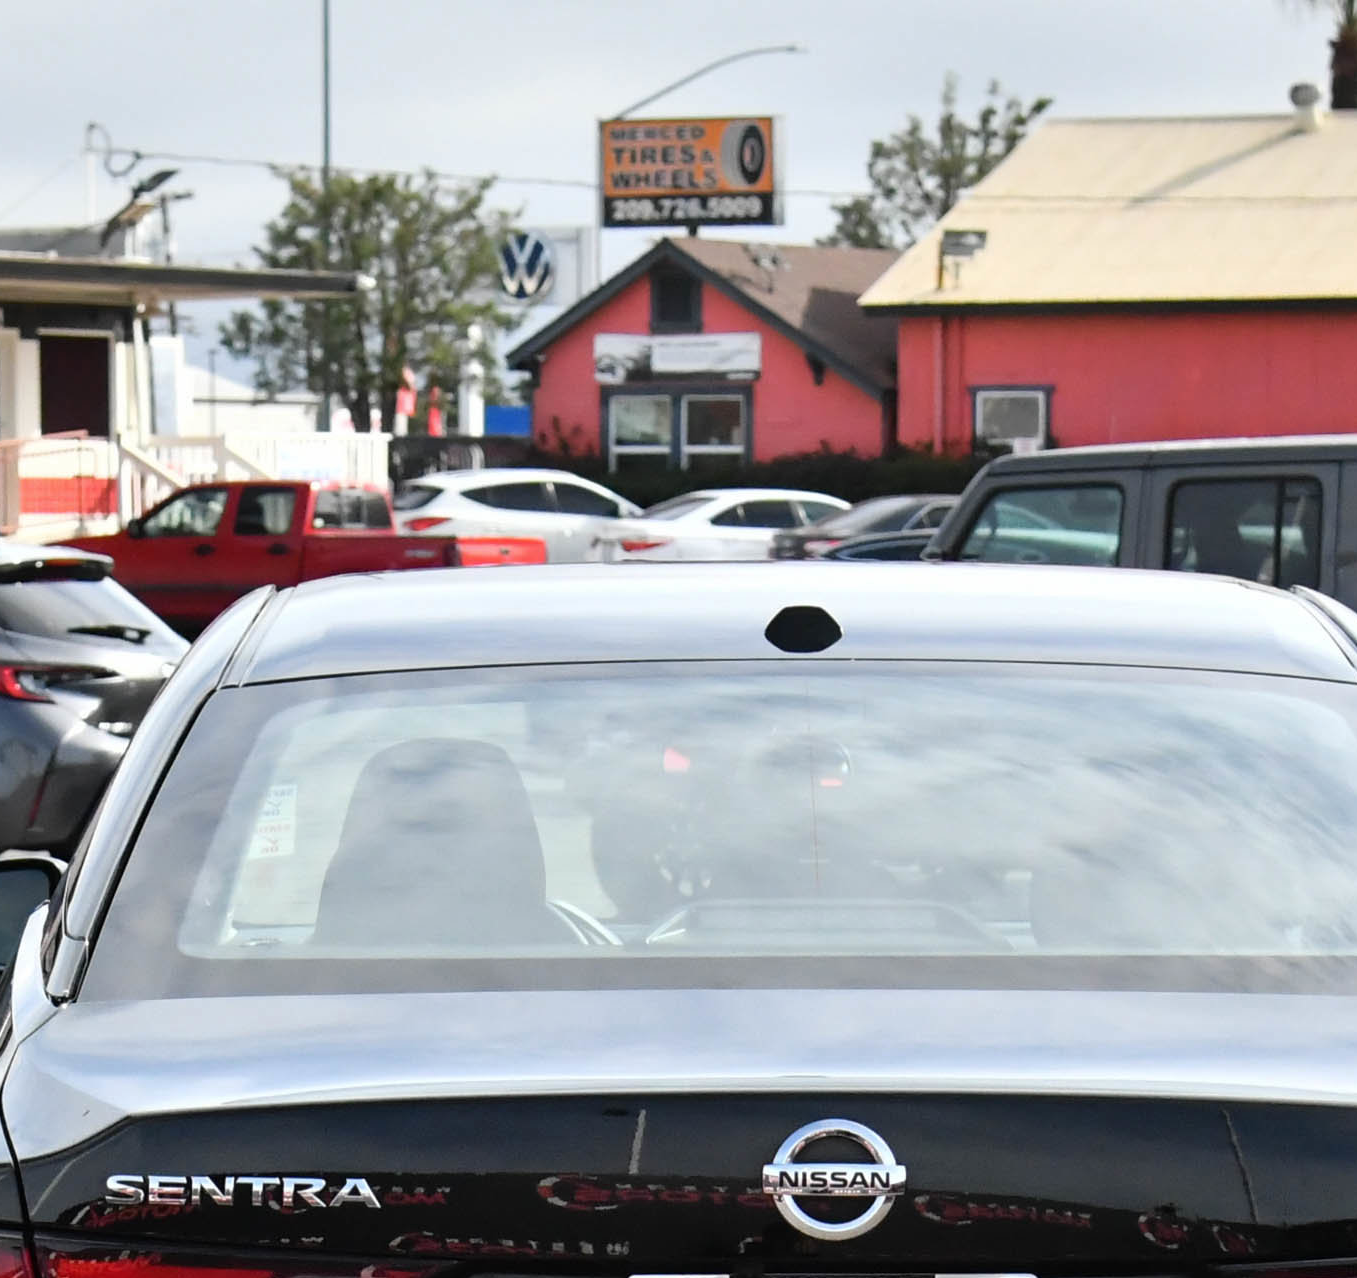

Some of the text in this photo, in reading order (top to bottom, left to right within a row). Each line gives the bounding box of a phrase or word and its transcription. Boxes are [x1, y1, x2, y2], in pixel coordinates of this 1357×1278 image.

[610, 126, 706, 141] MERCED
[611, 146, 695, 165] TIRES
[611, 170, 717, 189] WHEELS
[779, 1171, 890, 1189] NISSAN
[106, 1174, 381, 1208] SENTRA
